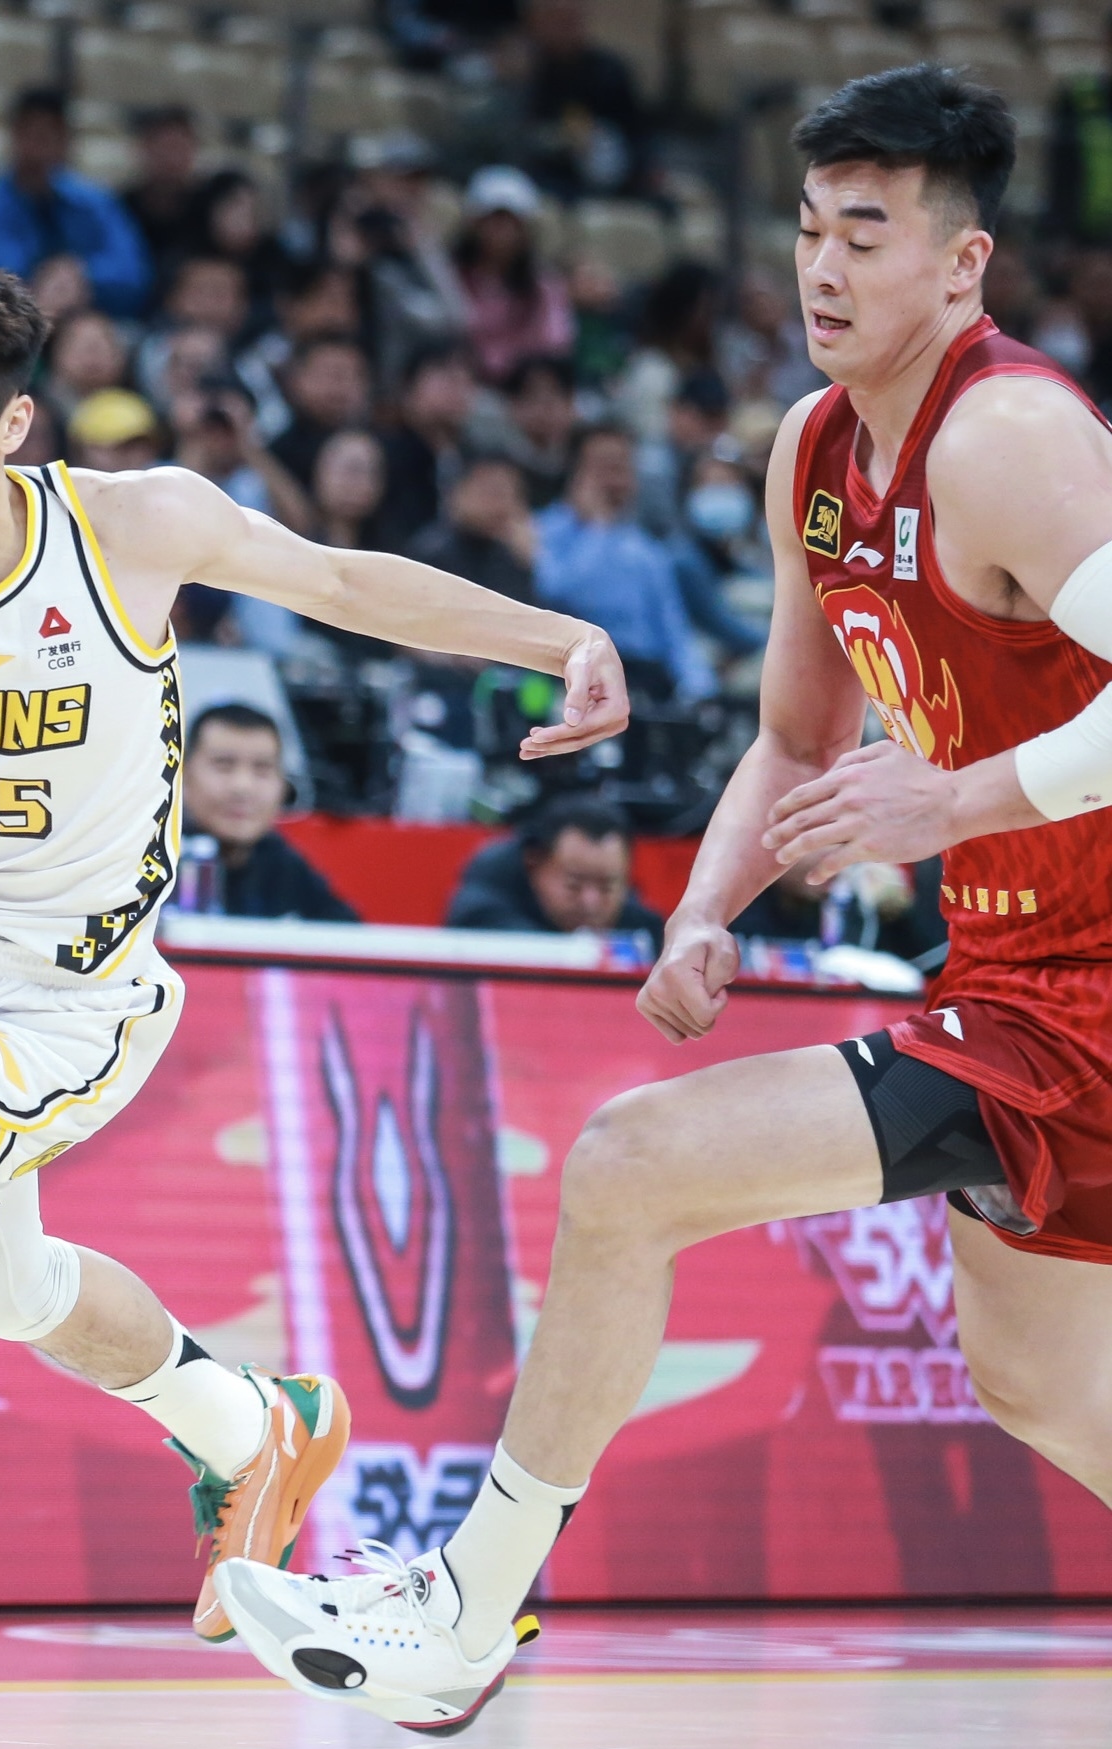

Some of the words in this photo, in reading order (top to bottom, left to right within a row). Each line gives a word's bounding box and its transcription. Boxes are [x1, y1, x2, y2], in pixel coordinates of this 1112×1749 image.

[37, 640, 81, 659] 广发银行
[48, 655, 75, 670] CGB
